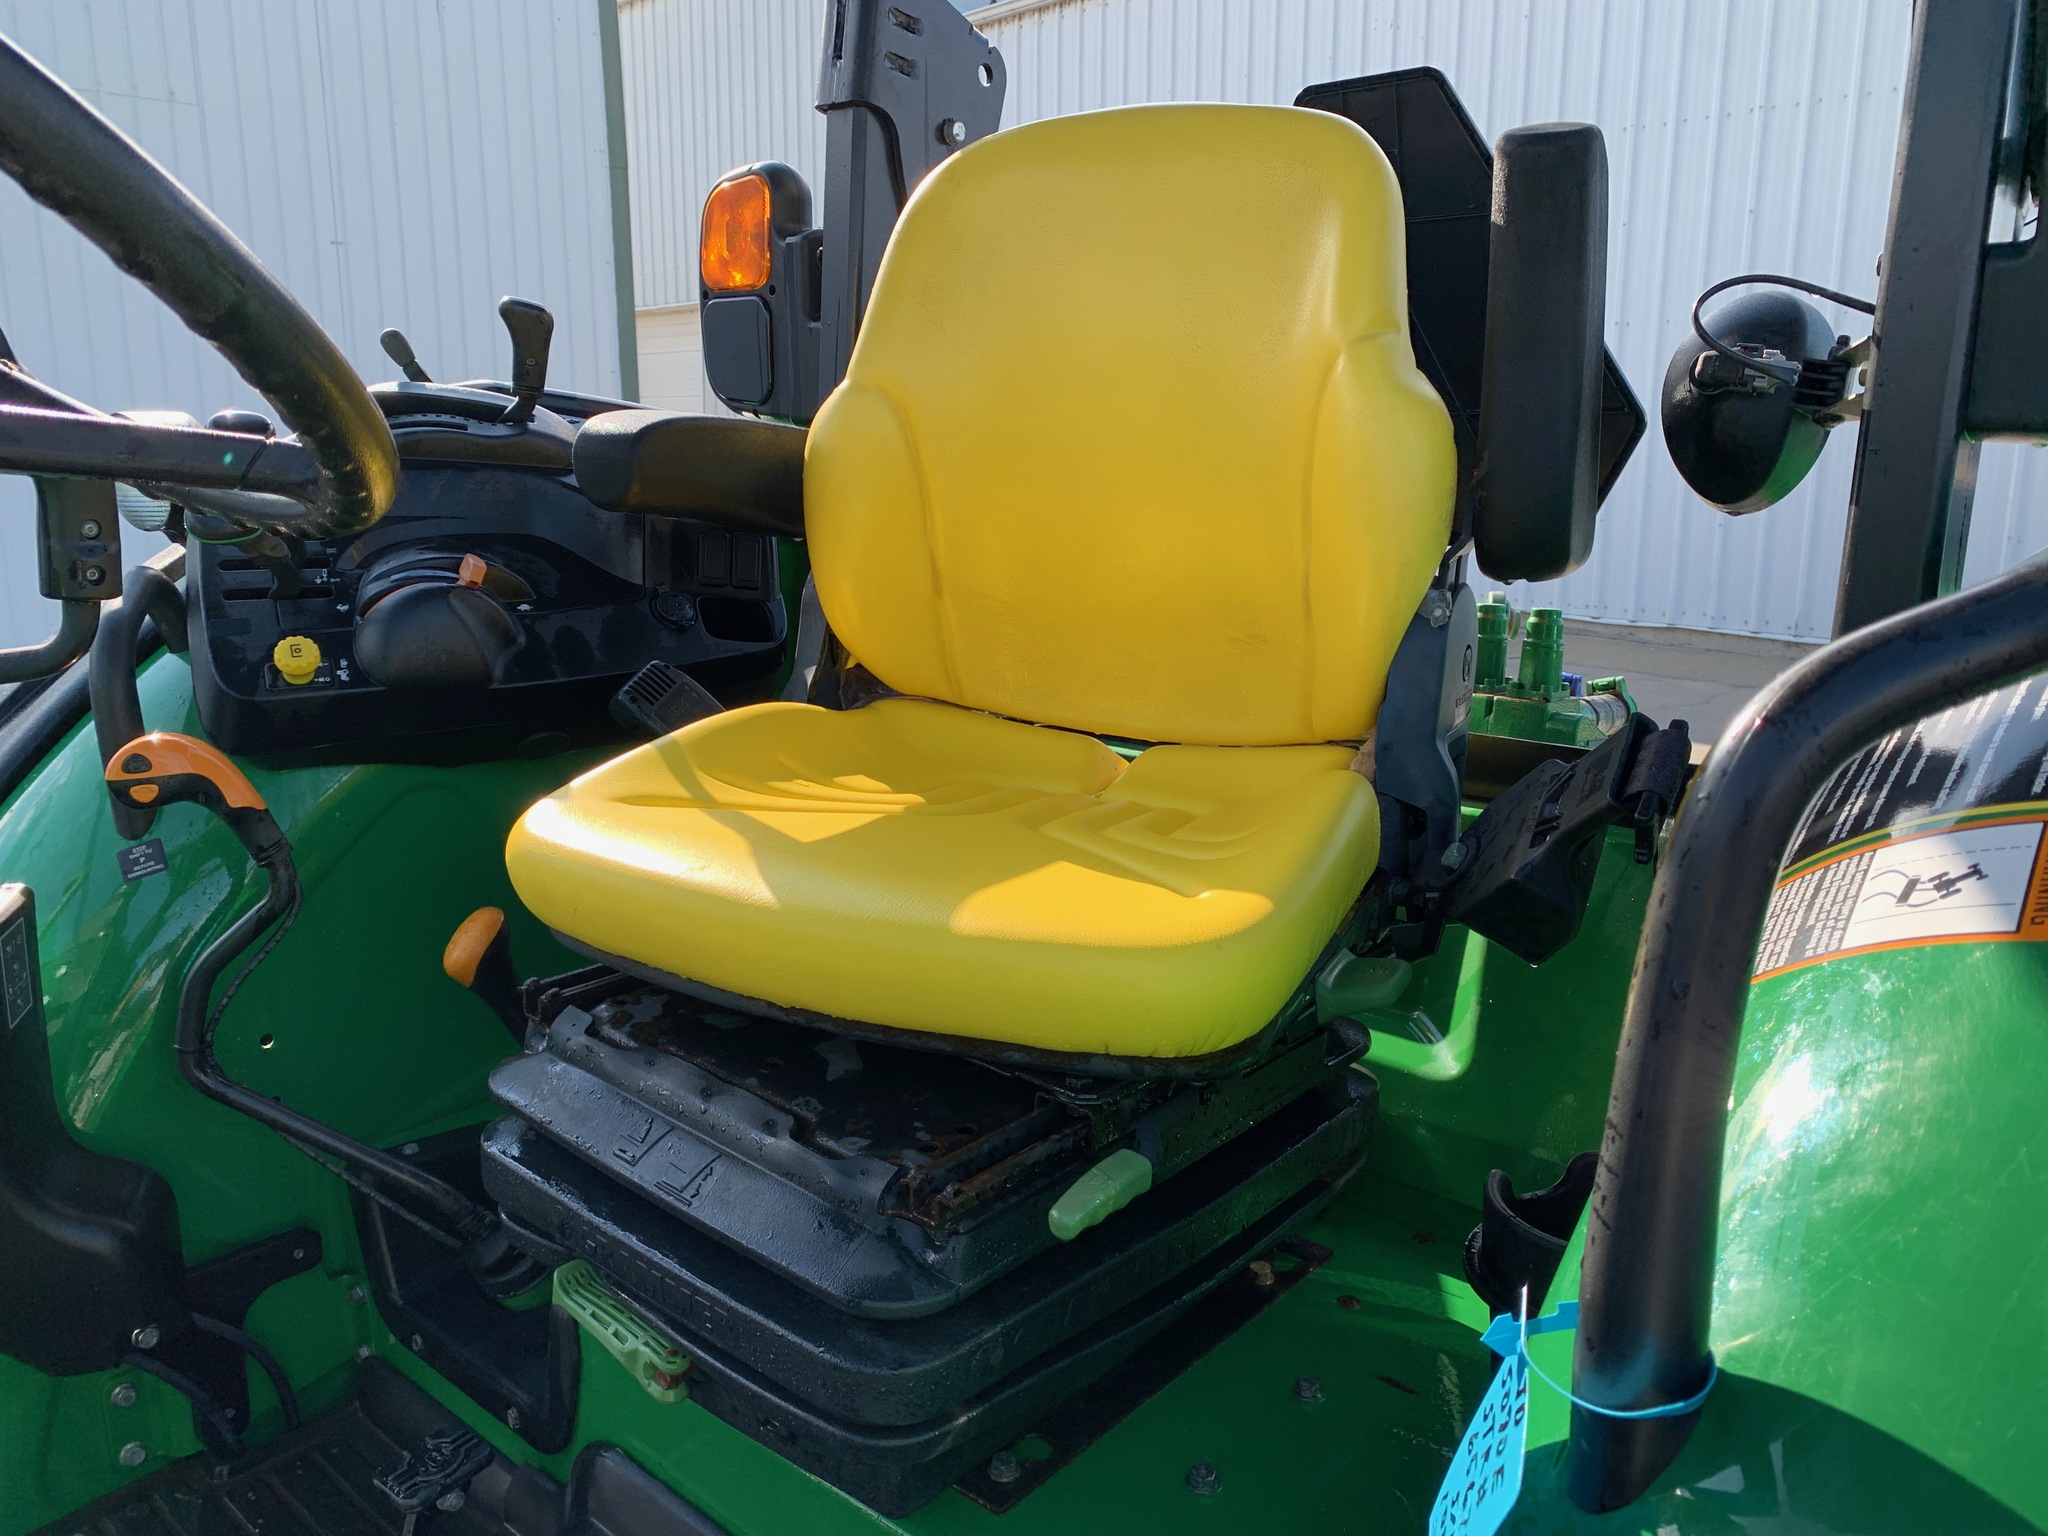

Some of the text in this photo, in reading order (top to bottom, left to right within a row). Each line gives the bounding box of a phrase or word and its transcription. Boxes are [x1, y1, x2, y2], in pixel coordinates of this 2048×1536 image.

[132, 845, 147, 853] STOP
[127, 863, 165, 879] DISMOUNTING
[133, 861, 155, 871] BEFORE
